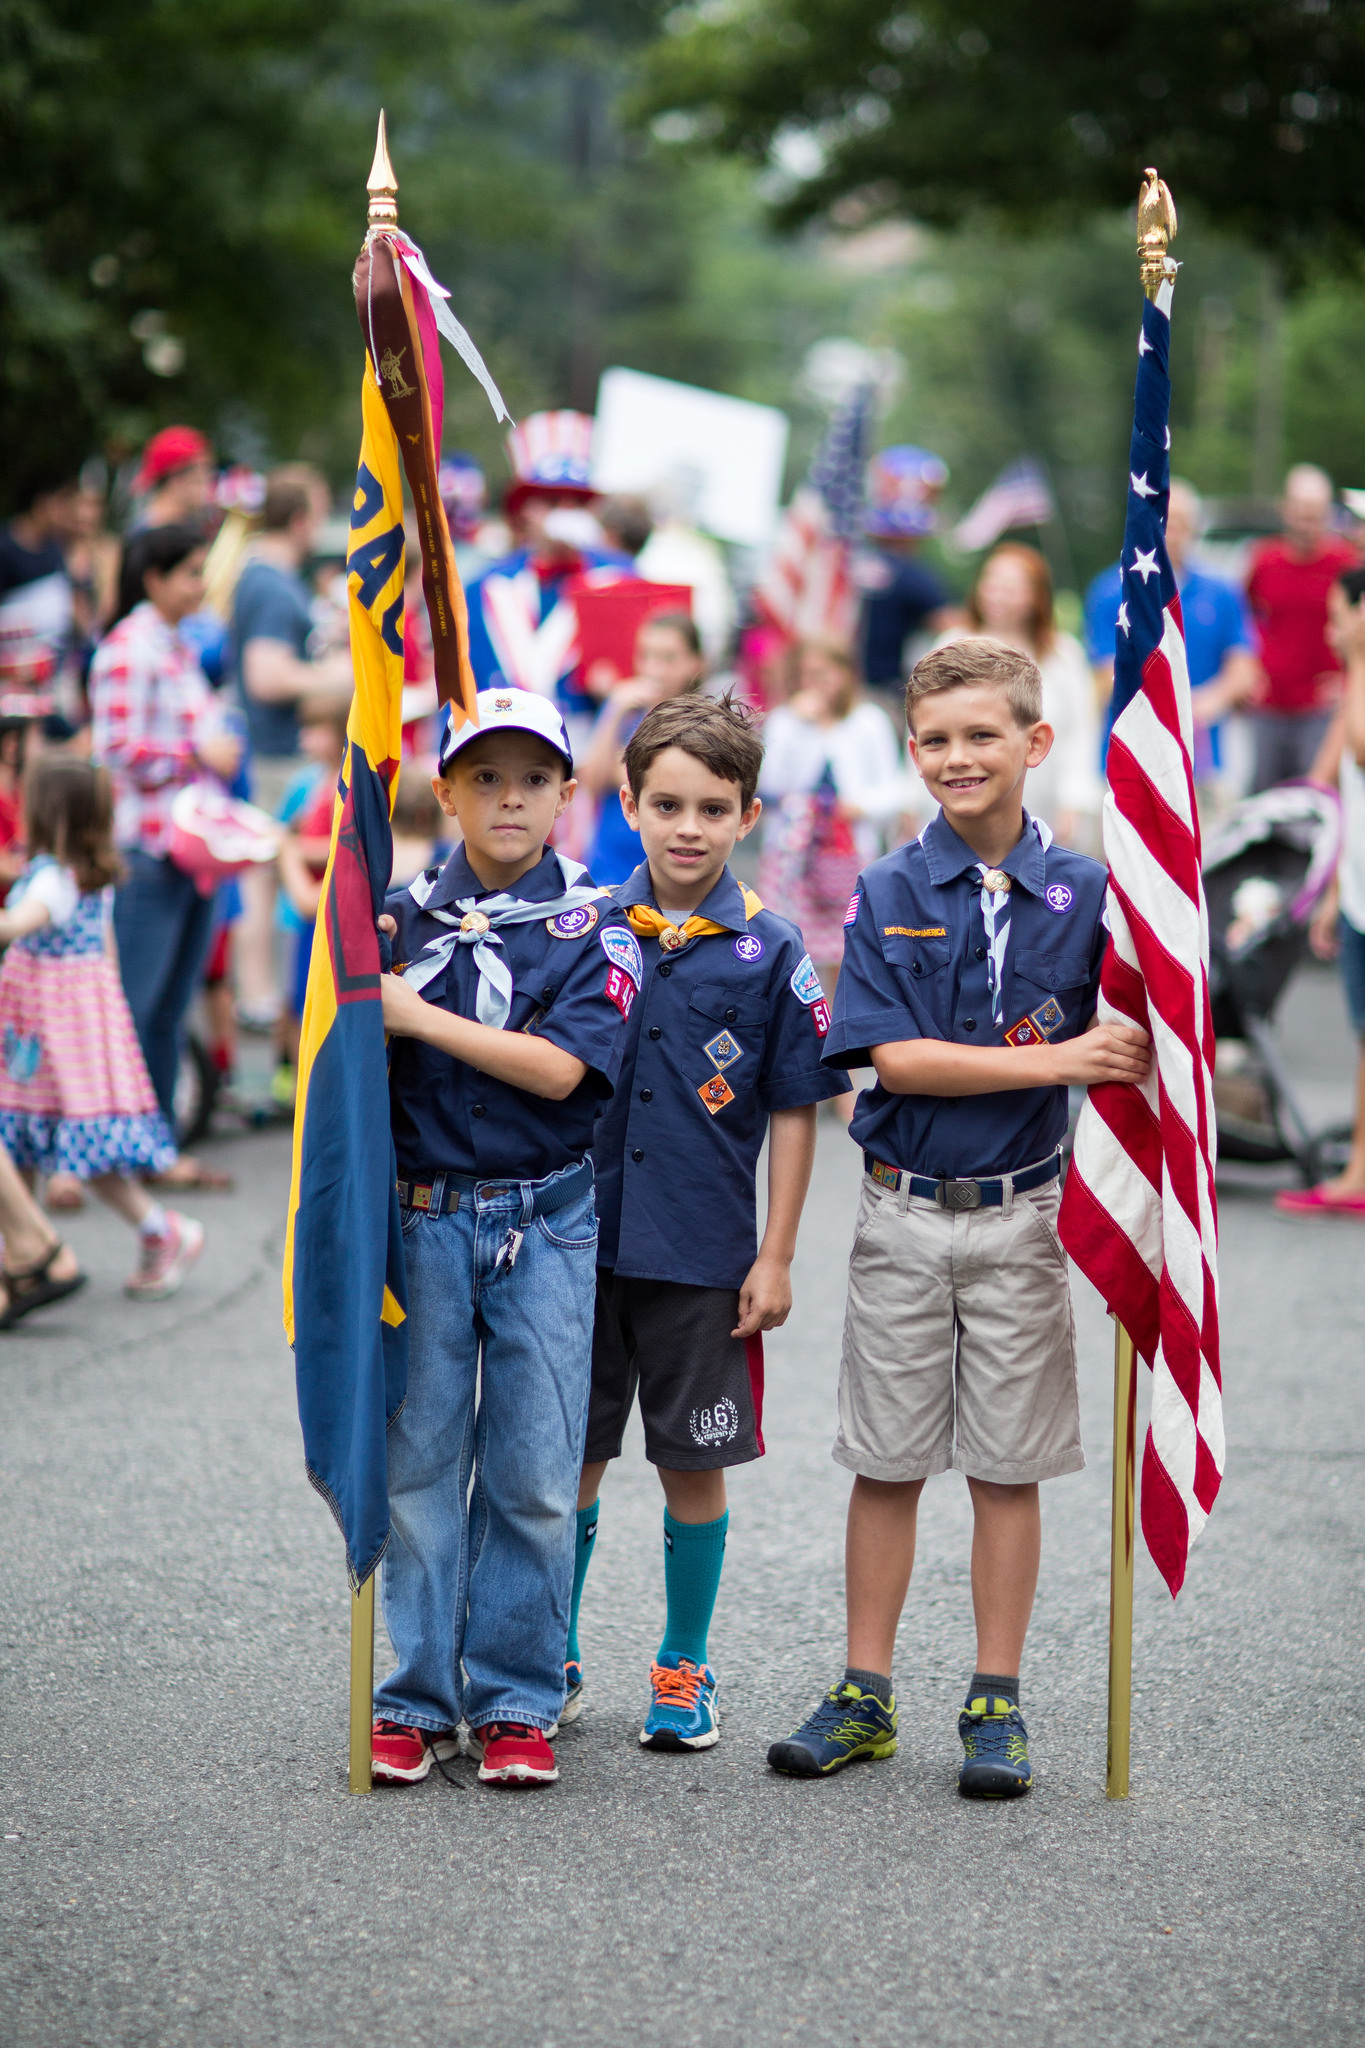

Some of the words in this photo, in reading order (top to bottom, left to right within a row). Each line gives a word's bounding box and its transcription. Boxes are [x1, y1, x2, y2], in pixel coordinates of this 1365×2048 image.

[424, 510, 436, 553] MOUNTAIN
[431, 559, 440, 579] MAN
[435, 584, 448, 637] RENDEZVOUS
[920, 928, 946, 937] AMERICA
[609, 968, 634, 1017] 548
[700, 1404, 729, 1429] 86
